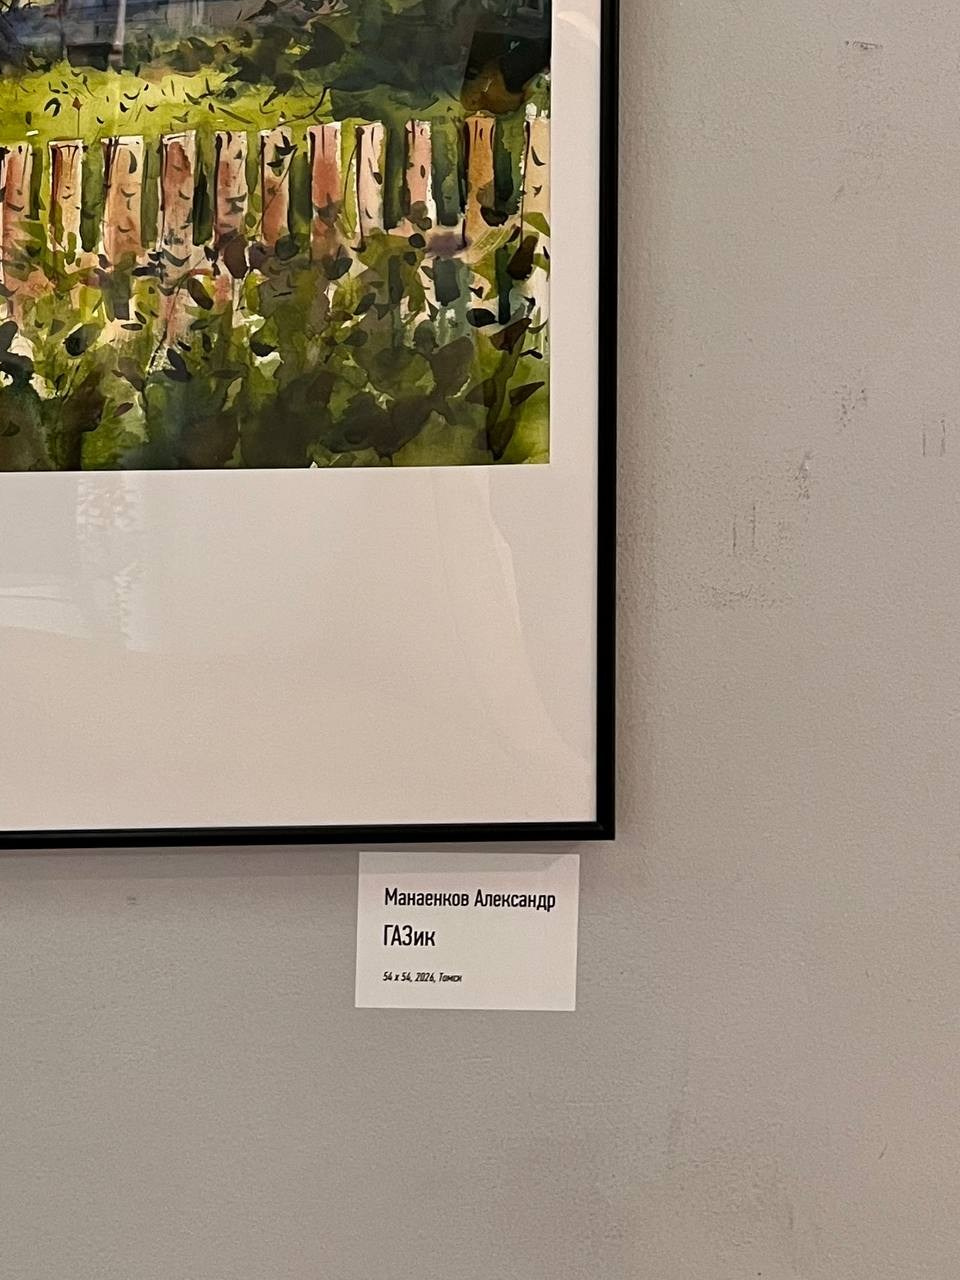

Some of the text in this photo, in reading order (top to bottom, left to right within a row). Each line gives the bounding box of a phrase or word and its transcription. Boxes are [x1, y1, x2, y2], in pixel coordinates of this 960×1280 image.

[384, 886, 556, 913] Манаенков Александр
[383, 924, 436, 947] ГАЗик
[382, 971, 392, 982] 54
[401, 971, 413, 983] 54,
